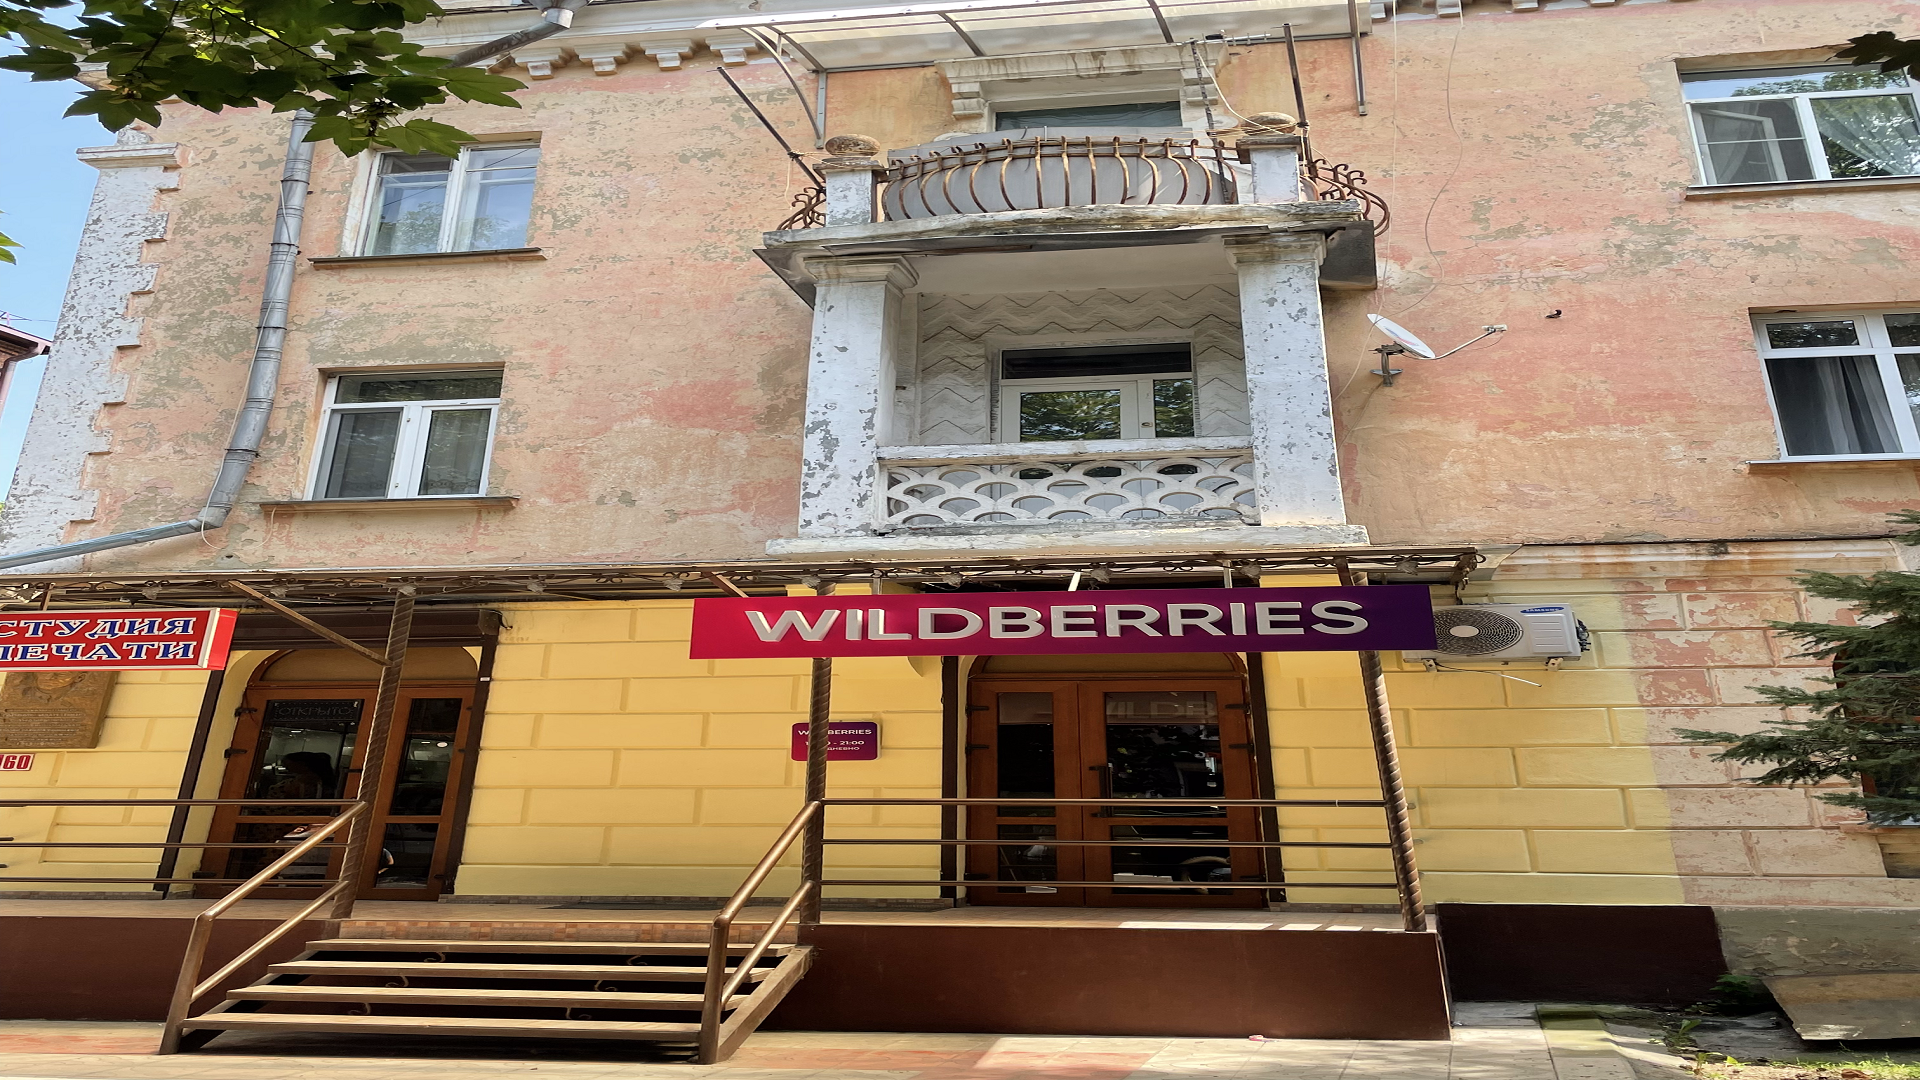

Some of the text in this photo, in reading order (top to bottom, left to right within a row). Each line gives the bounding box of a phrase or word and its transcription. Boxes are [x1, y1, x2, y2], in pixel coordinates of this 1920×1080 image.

[0, 617, 197, 639] СТУДИЯ
[744, 600, 1369, 643] WILDBERRIES
[279, 706, 351, 716] ОТКРЫТО
